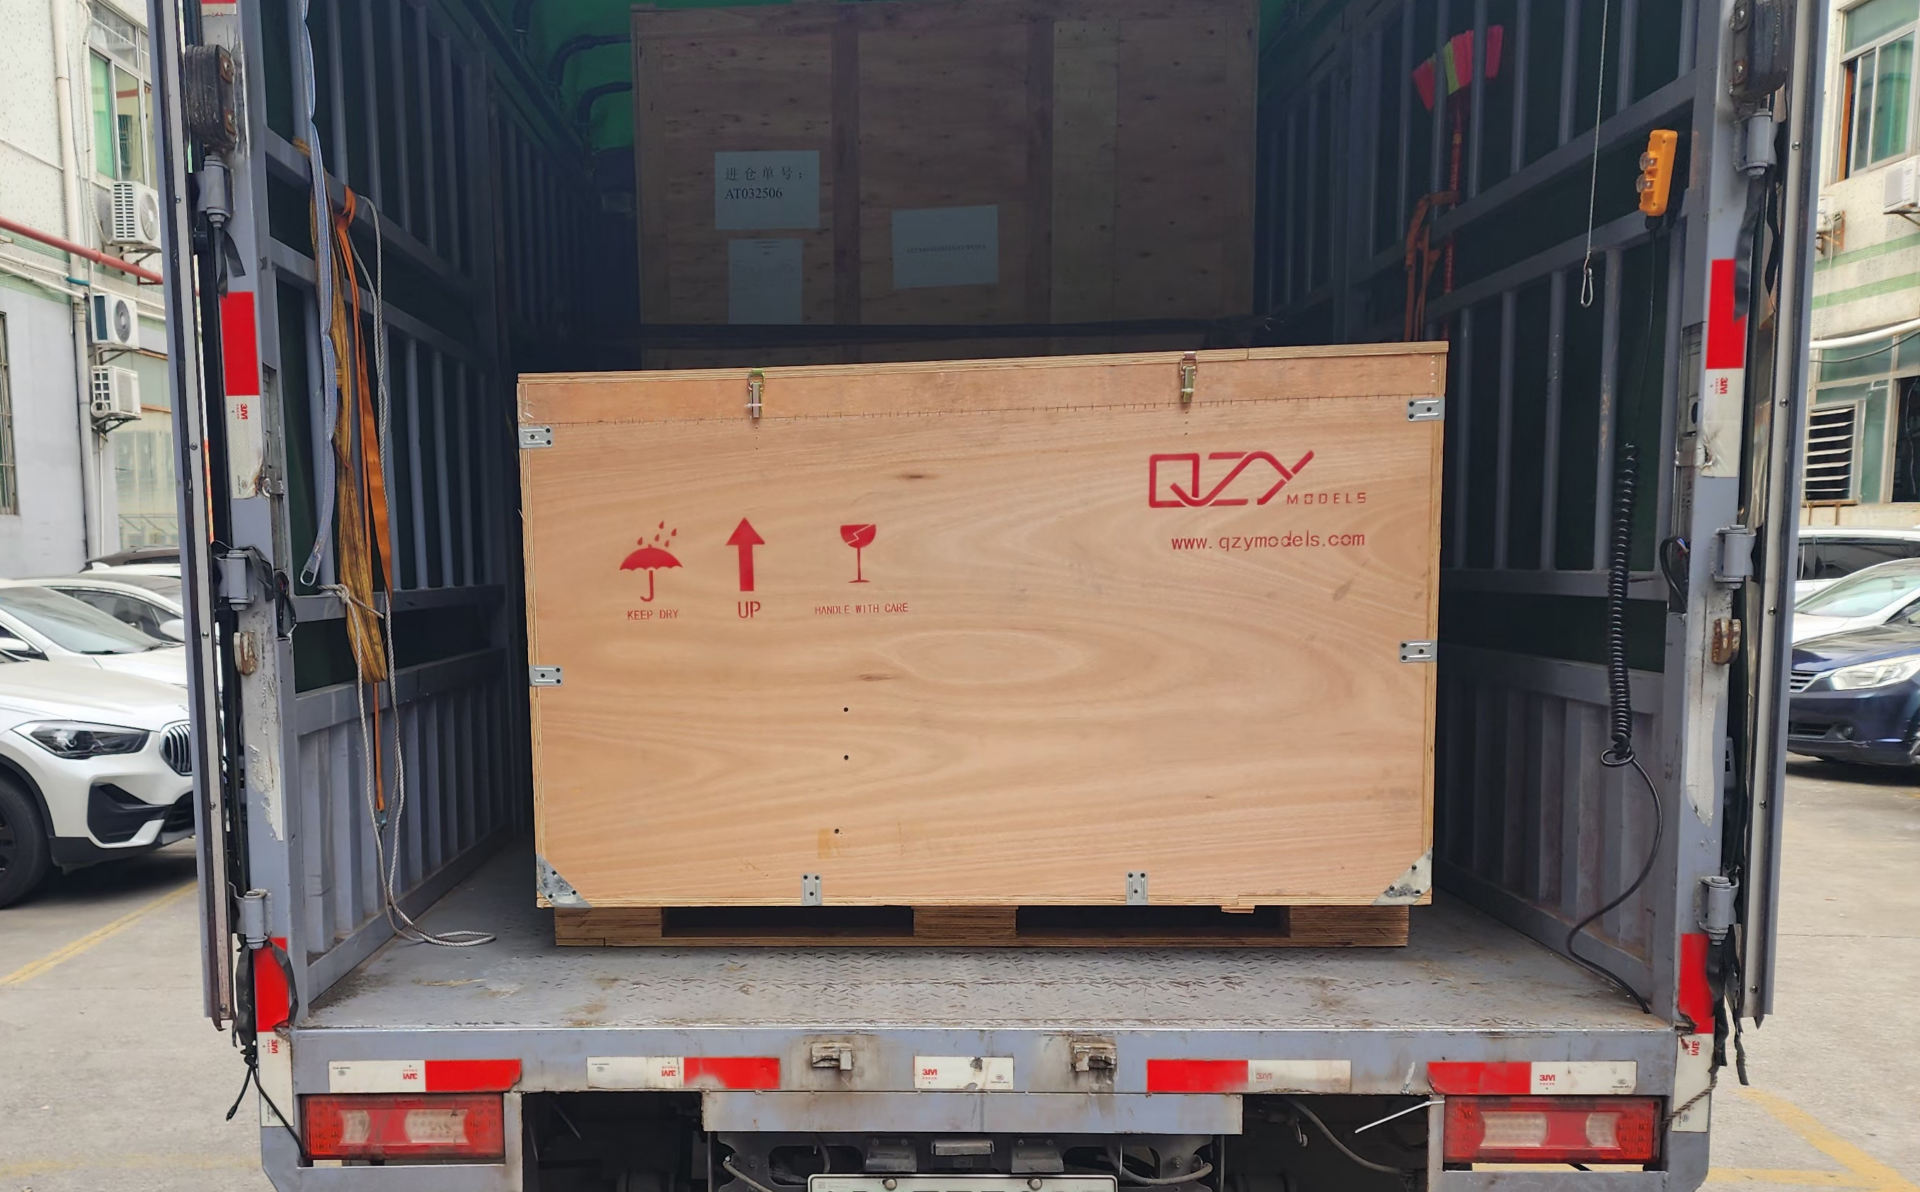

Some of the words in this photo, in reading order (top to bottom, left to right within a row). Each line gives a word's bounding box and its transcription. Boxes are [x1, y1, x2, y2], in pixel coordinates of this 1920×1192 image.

[725, 187, 783, 199] AT032506
[1720, 377, 1729, 395] 3M
[240, 403, 249, 420] 3M
[1148, 450, 1314, 508] QZY
[1286, 493, 1366, 505] MODELS
[1171, 531, 1365, 551] www.qzymodels.com
[627, 610, 653, 621] KEEP
[659, 609, 679, 619] DRY
[737, 601, 761, 618] UP
[814, 605, 850, 615] HANDLE
[855, 604, 879, 614] WITH
[884, 603, 909, 613] CARE
[402, 1072, 418, 1080] 3M
[661, 1069, 676, 1077] 3M
[922, 1068, 938, 1076] 3M
[1539, 1074, 1556, 1082] 3M
